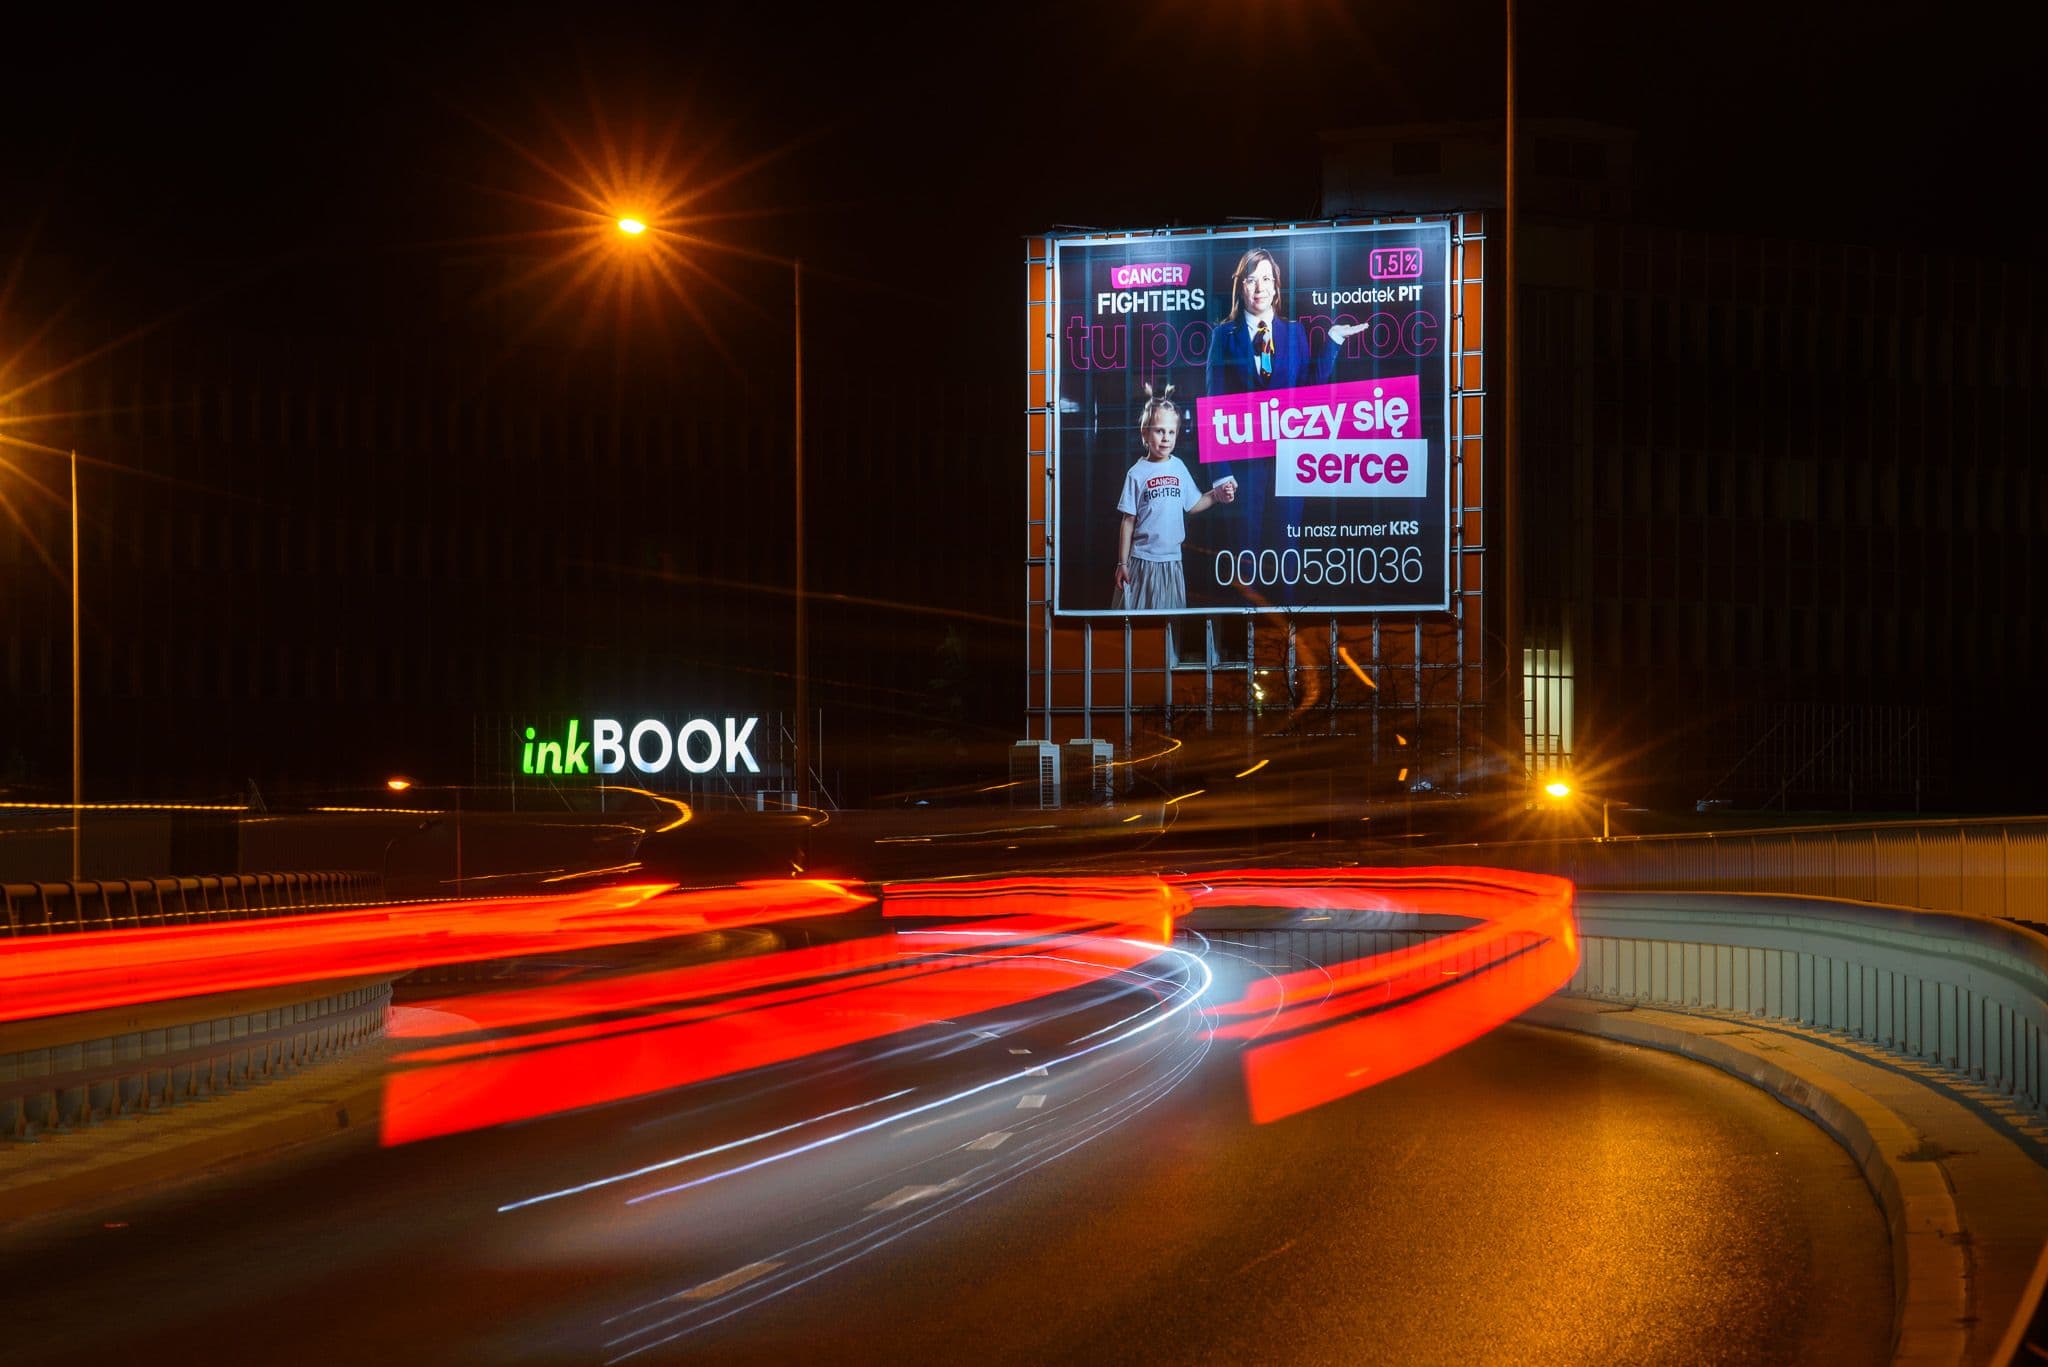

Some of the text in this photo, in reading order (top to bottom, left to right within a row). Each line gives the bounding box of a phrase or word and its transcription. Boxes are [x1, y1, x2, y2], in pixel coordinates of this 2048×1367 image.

[1117, 266, 1183, 285] CANCER
[1097, 288, 1206, 315] FIGHTERS
[1312, 286, 1423, 309] tu podatek PIT
[1066, 316, 1127, 370] tu
[1212, 387, 1409, 446] tu liczy się
[1149, 476, 1178, 488] CANCER
[1295, 452, 1409, 484] serce
[1287, 521, 1419, 538] tu nasz numer KRS
[1214, 546, 1423, 587] 0000581036
[522, 717, 761, 774] inkBOOK
